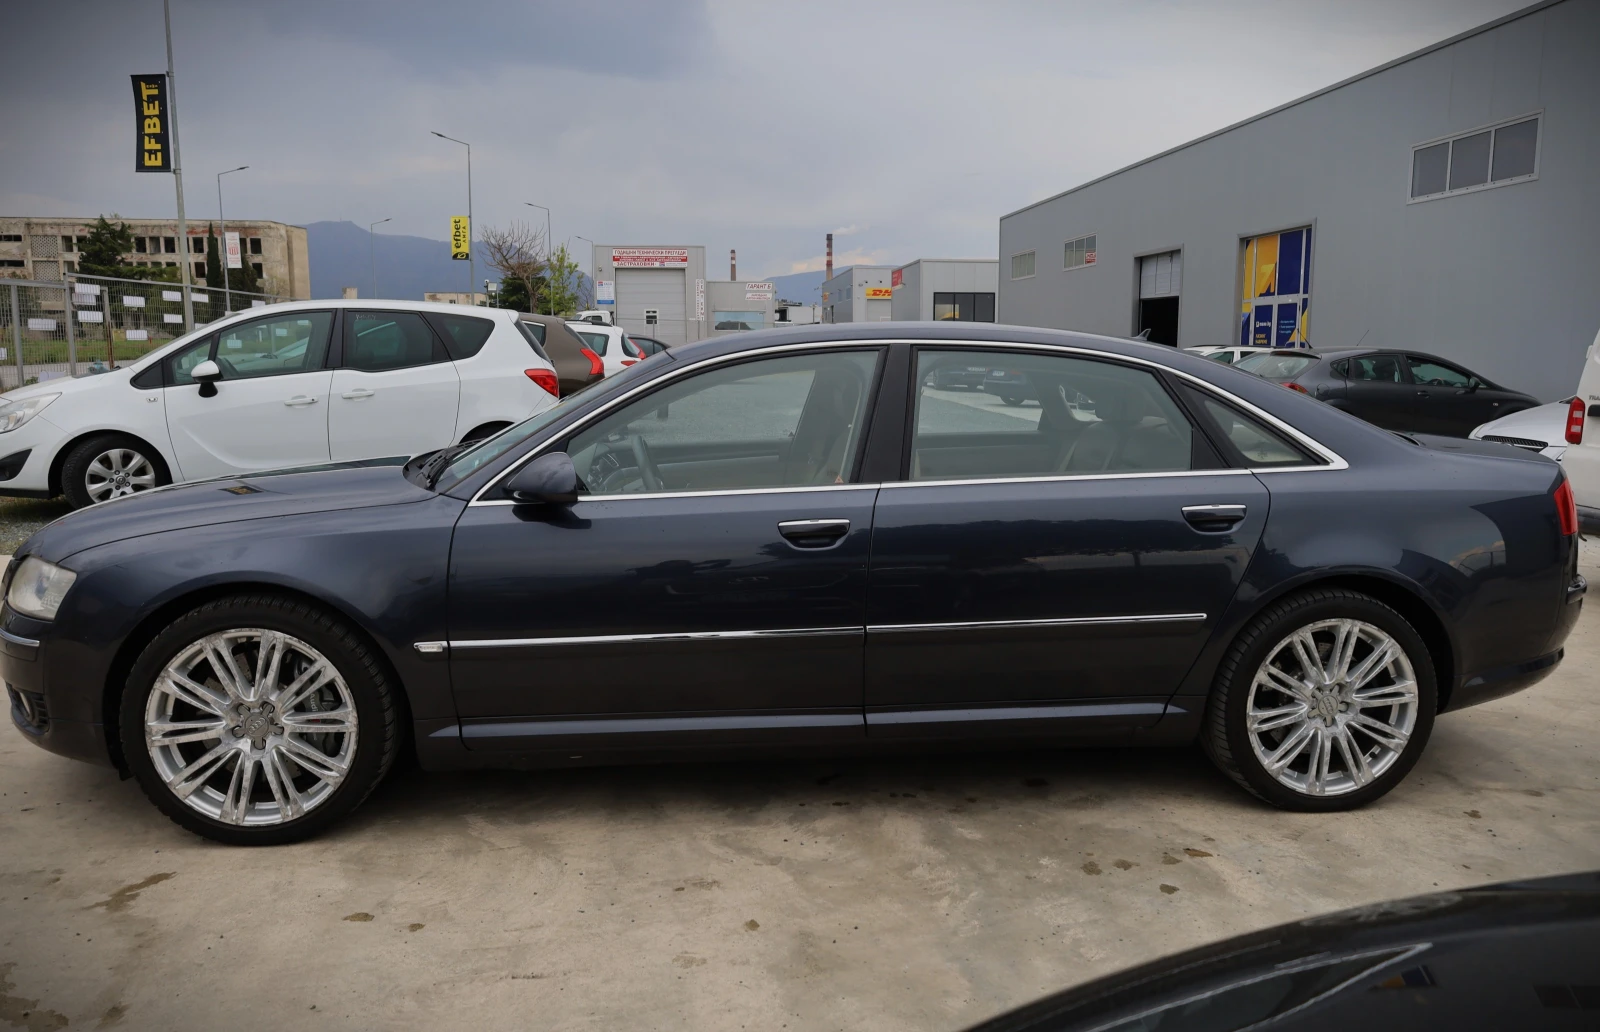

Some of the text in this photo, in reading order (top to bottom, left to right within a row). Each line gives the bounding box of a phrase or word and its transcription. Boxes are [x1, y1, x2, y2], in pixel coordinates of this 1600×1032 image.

[141, 81, 162, 166] EFBET
[453, 219, 462, 249] efbet
[310, 693, 319, 711] Audi
